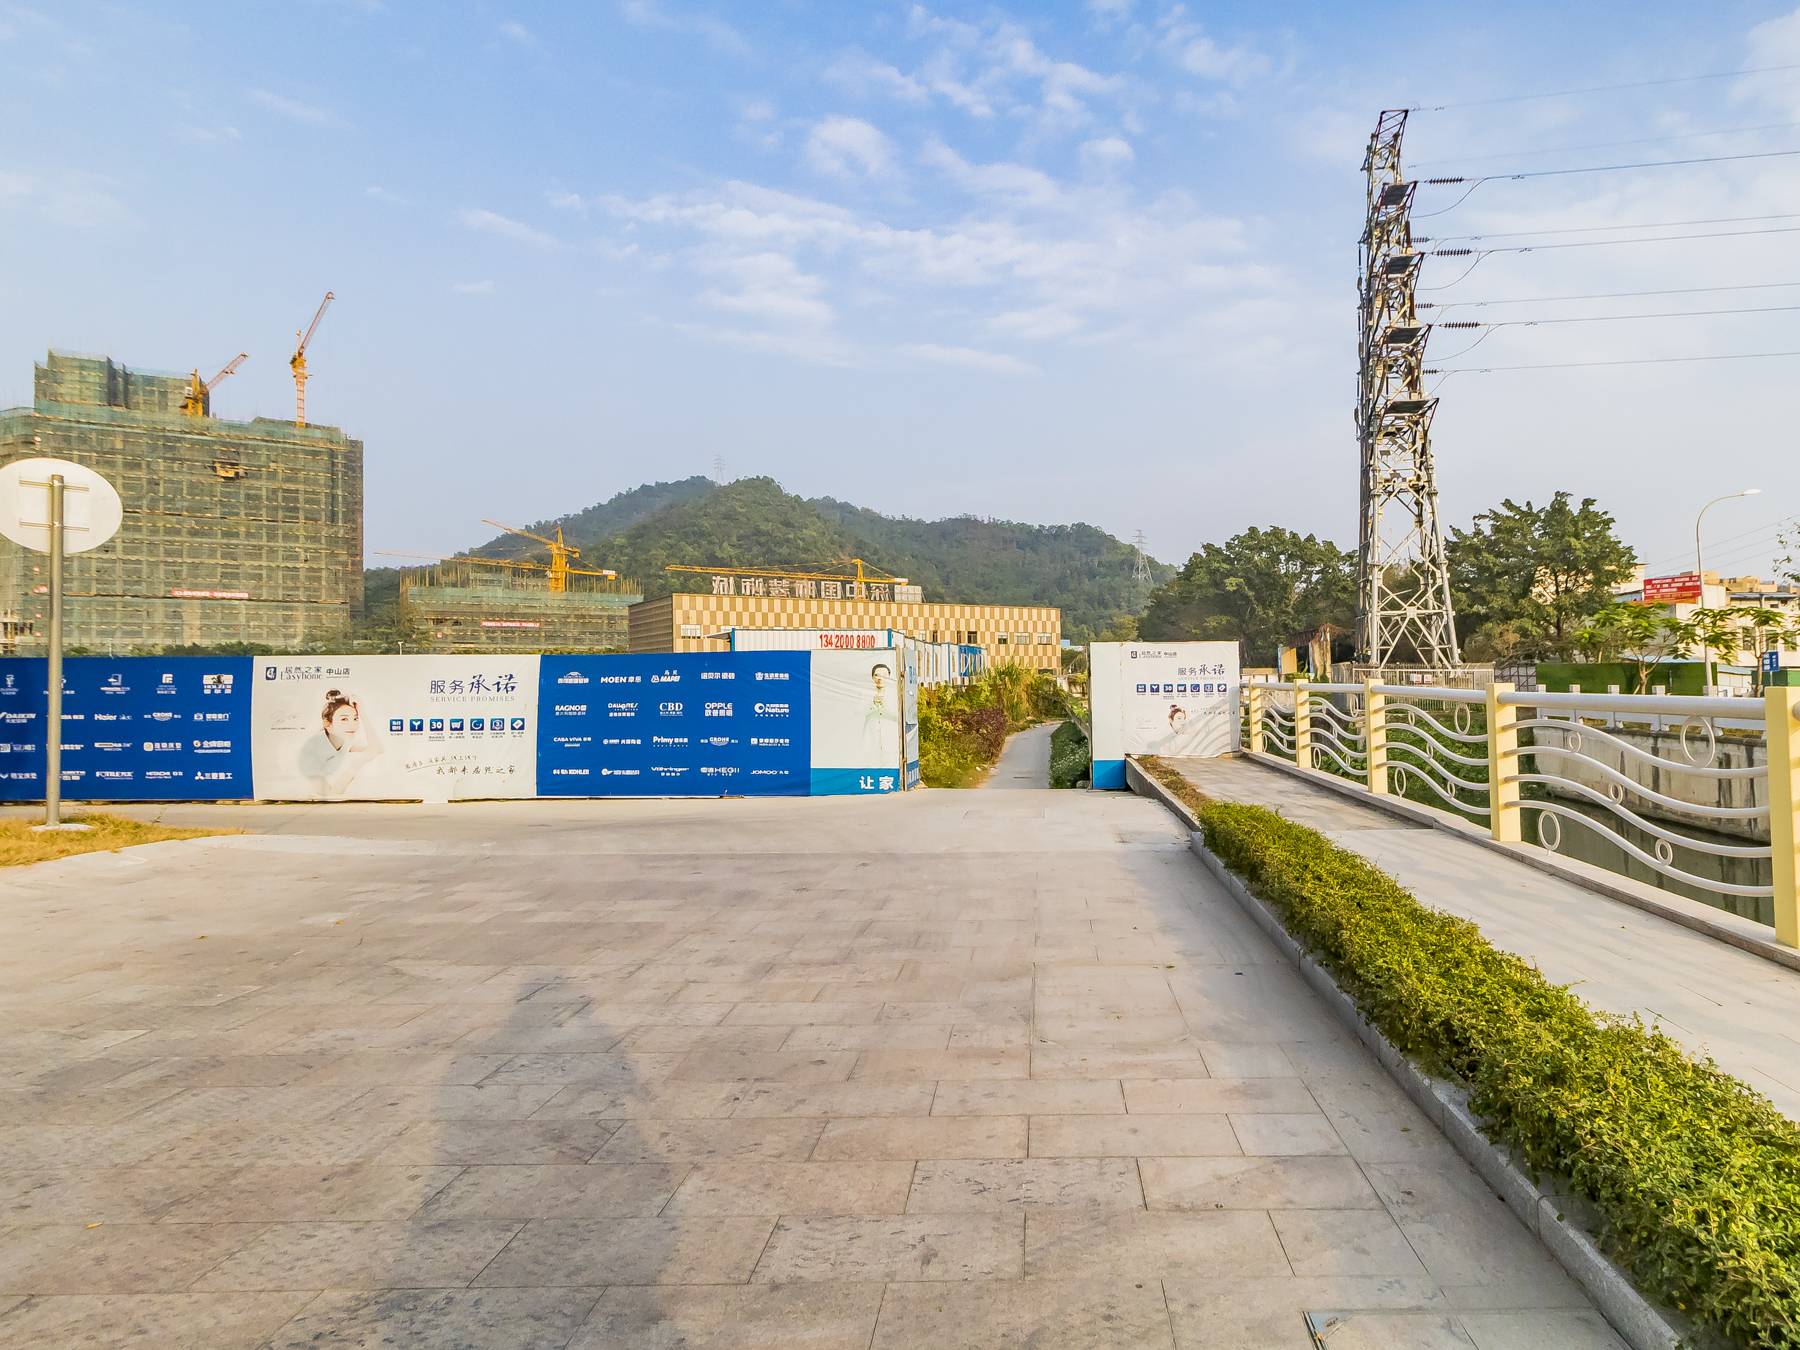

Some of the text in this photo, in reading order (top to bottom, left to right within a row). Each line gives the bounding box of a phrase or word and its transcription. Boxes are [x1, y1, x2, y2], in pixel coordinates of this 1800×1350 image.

[819, 634, 875, 648] 134 2000 8800
[326, 667, 350, 676] 中山店
[1177, 663, 1225, 676] 服务承诺
[429, 673, 518, 694] 服务承诺
[555, 704, 581, 712] RAGNO
[659, 703, 683, 711] CBD
[705, 702, 733, 710] OPPLE
[431, 721, 443, 729] 30
[860, 775, 894, 791] 让家
